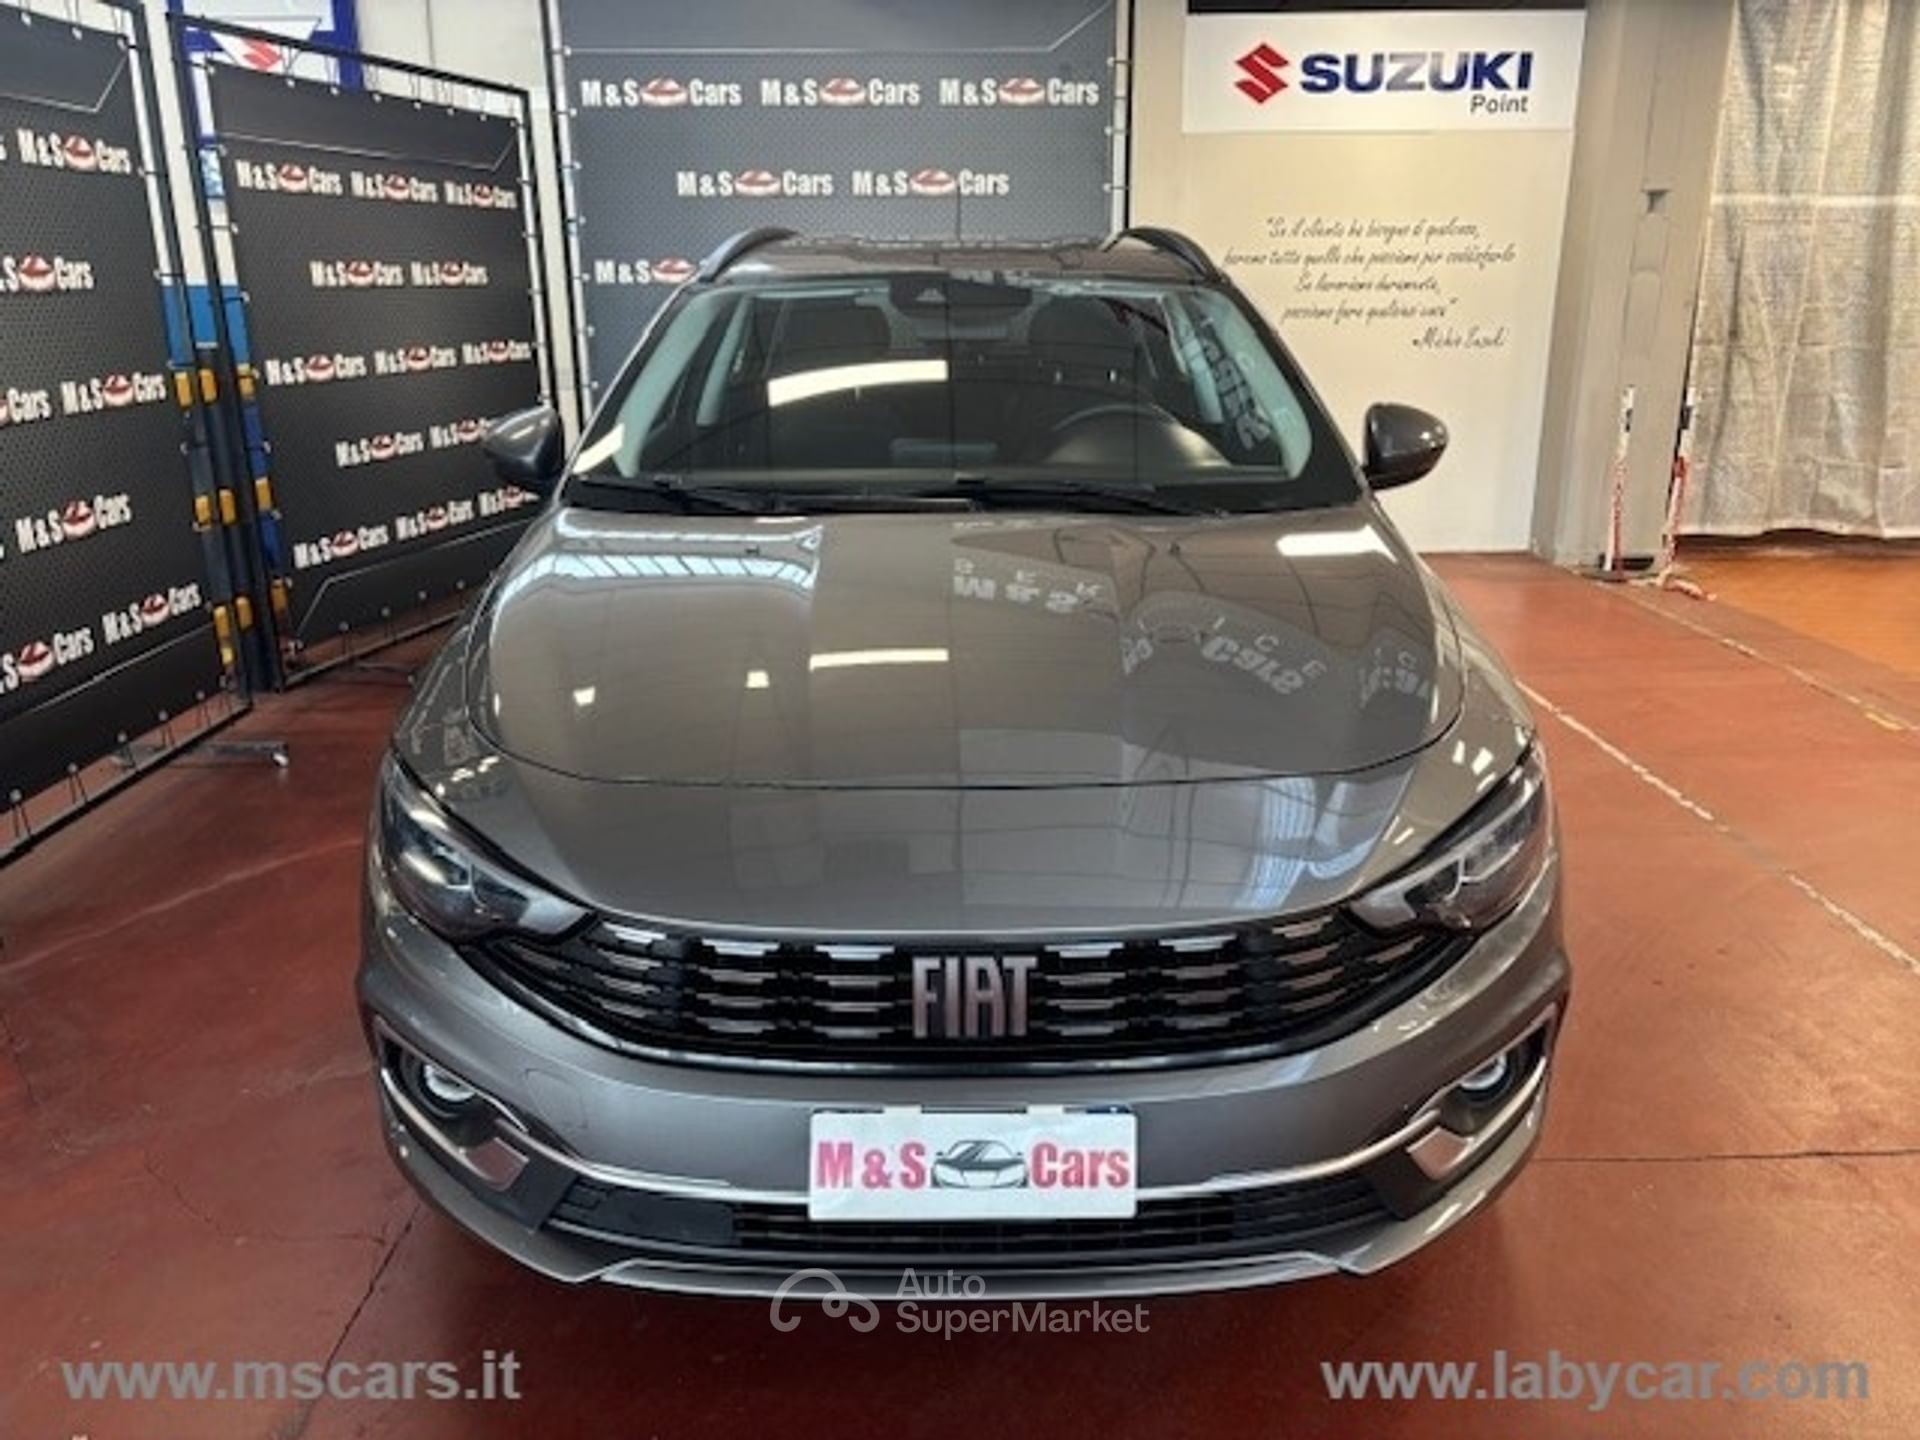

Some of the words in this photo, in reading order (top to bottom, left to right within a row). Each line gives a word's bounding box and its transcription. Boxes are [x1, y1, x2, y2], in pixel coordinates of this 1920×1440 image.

[1299, 51, 1534, 93] SUZUKI
[688, 78, 742, 106] Cars
[868, 78, 920, 105] Cars
[1048, 78, 1100, 105] Cars
[1470, 94, 1529, 113] Point
[95, 139, 131, 174] Cars
[308, 165, 343, 195] Cars
[409, 177, 439, 202] Cars
[494, 186, 517, 209] Cars
[782, 170, 833, 196] Cars
[958, 168, 1009, 195] Cars
[54, 256, 94, 289] Cars
[373, 260, 404, 286] Cars
[463, 261, 488, 285] Cars
[334, 353, 367, 379] Cars
[431, 345, 457, 368] Cars
[508, 340, 531, 359] Cars
[7, 388, 51, 423] Cars
[132, 372, 166, 402] Cars
[395, 432, 424, 455] Cars
[93, 493, 131, 529] Cars
[357, 525, 389, 551] Cars
[448, 501, 475, 525] Cars
[53, 627, 94, 665] Cars
[168, 583, 201, 615] Cars
[912, 956, 1038, 1038] FIAT
[1031, 1142, 1131, 1189] Cars
